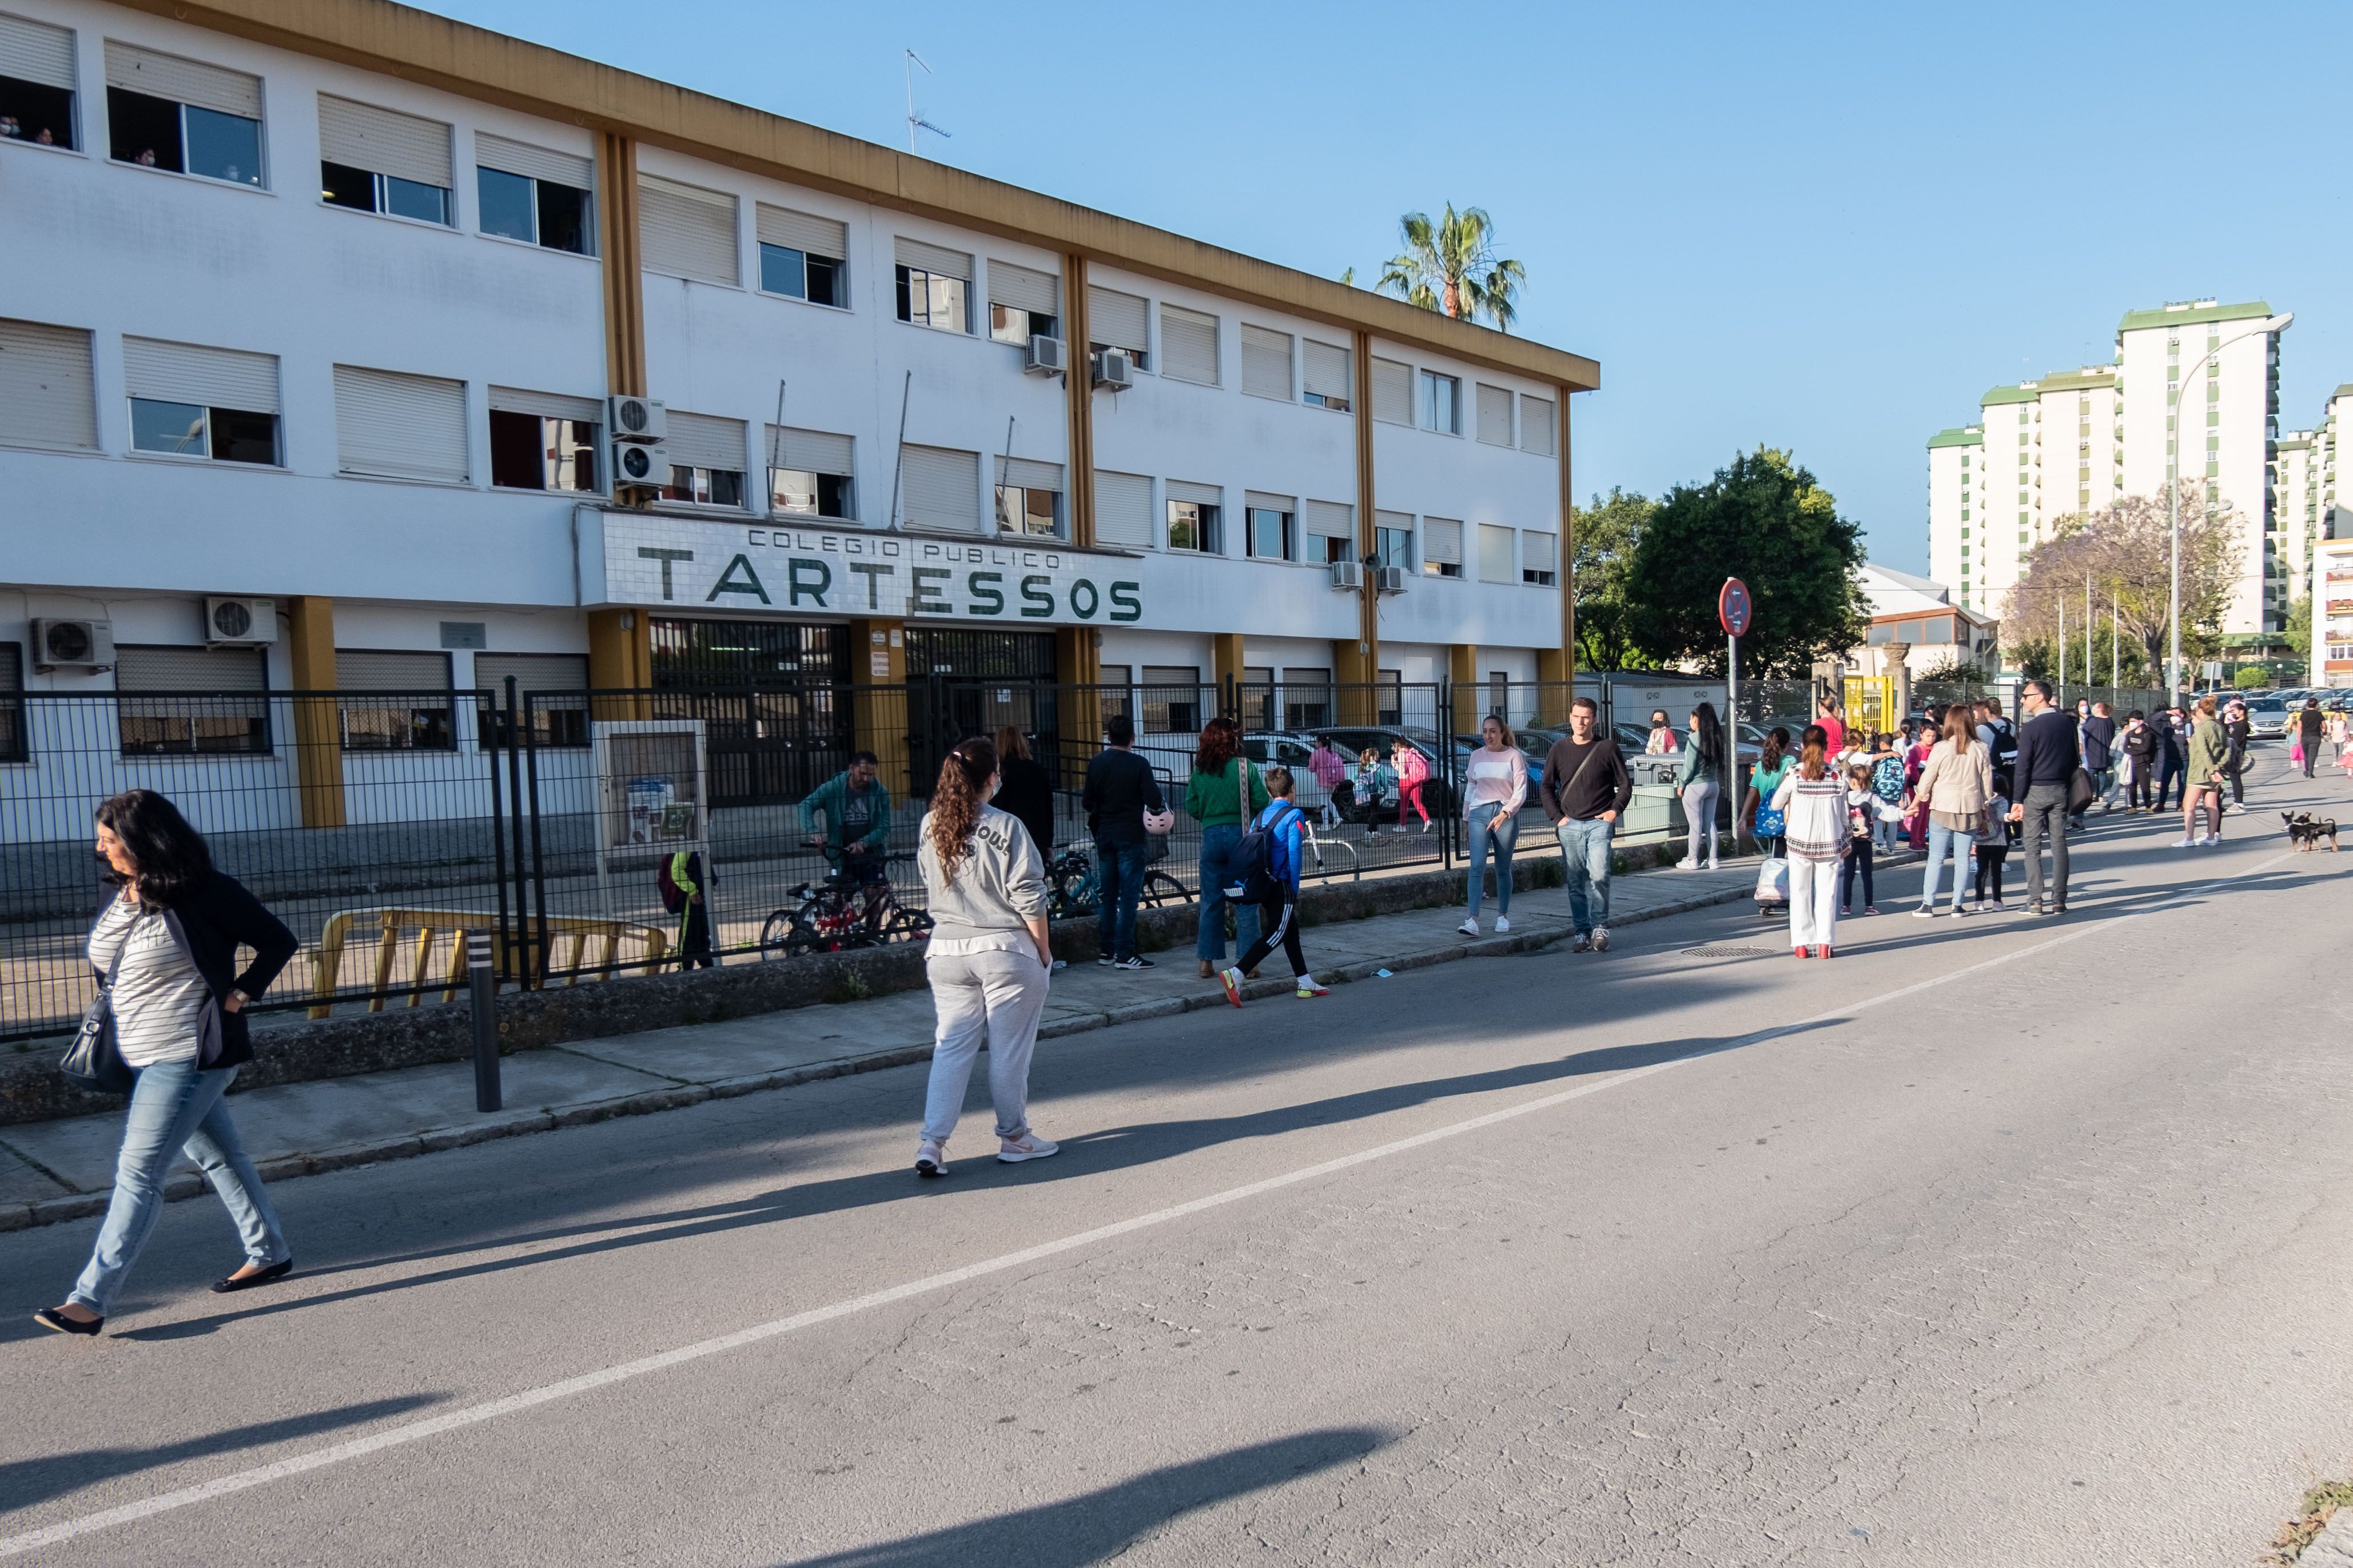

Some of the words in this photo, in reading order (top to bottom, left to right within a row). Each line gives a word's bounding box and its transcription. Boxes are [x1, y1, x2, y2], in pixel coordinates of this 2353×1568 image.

[748, 529, 899, 557] COLEGIO
[923, 544, 1060, 569] PUBLICO
[637, 546, 1142, 622] TARTESSOS
